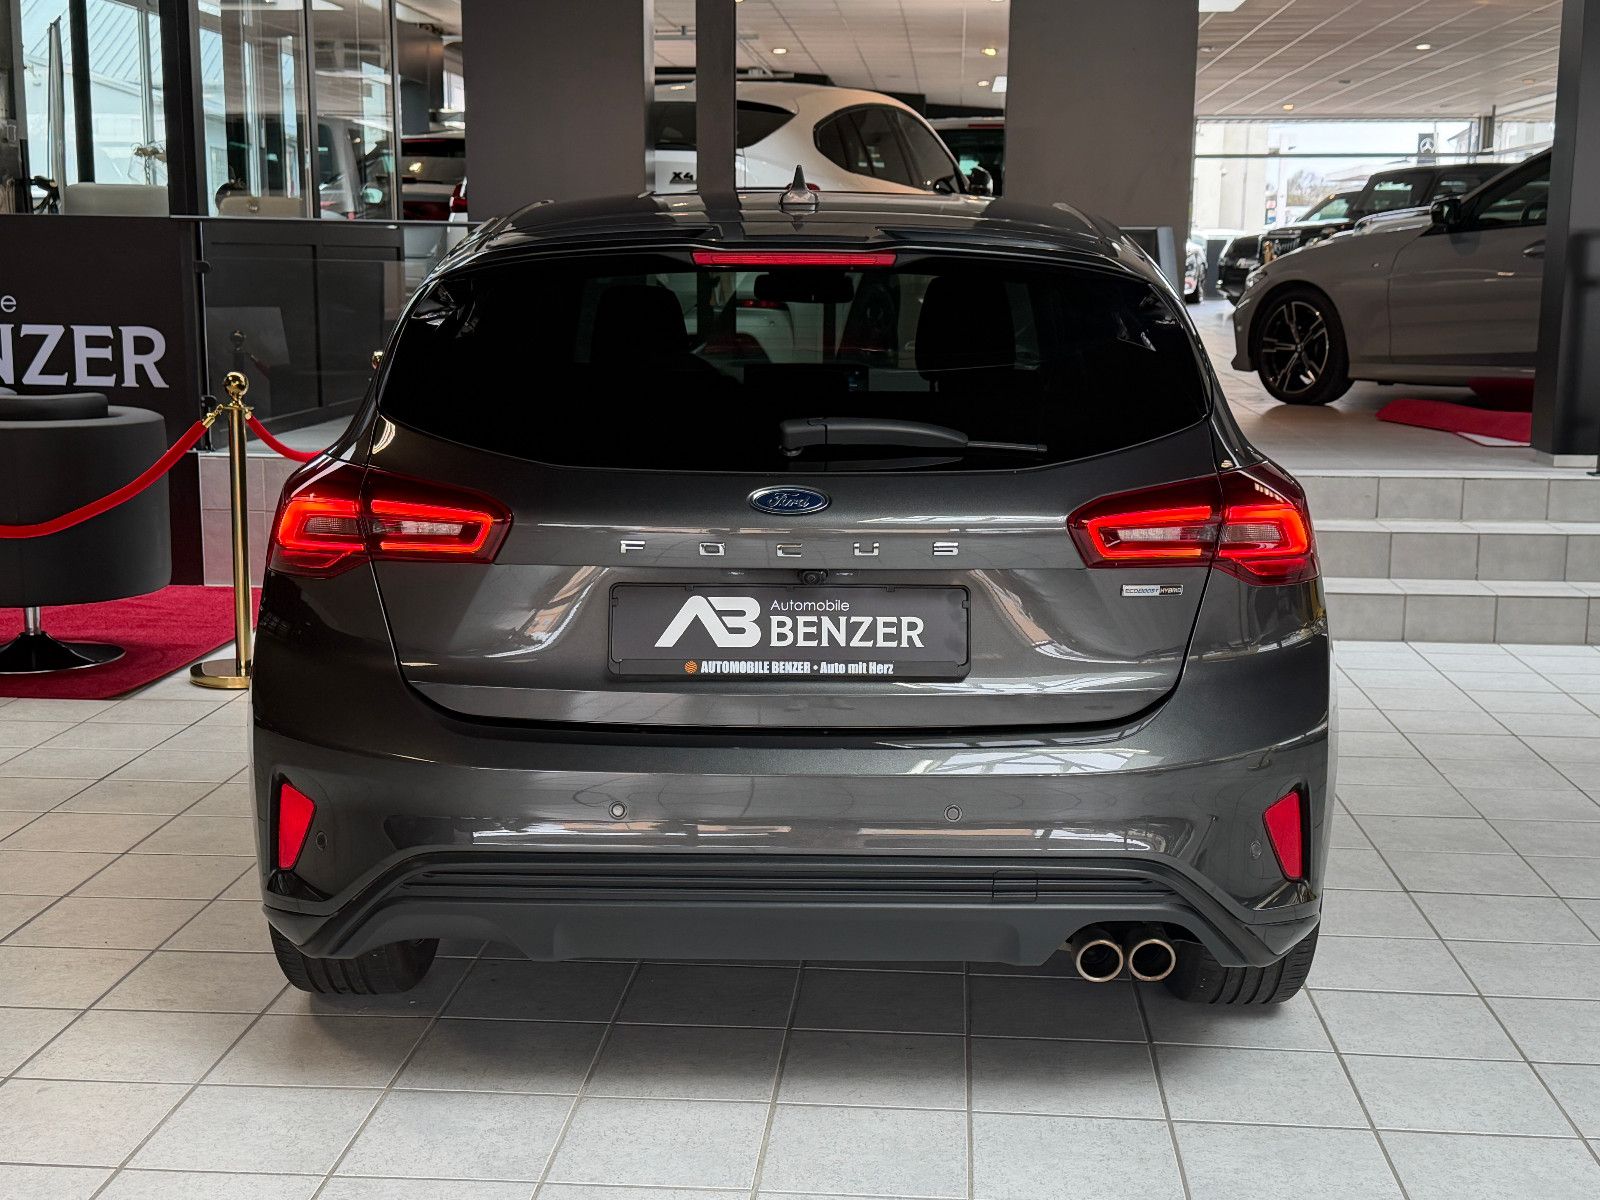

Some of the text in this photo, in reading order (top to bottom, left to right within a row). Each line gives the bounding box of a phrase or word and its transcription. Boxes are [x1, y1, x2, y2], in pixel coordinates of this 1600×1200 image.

[768, 492, 810, 508] Ford
[620, 540, 960, 557] FOCUS
[769, 599, 850, 612] Automobile
[769, 615, 925, 648] BENZER
[700, 660, 894, 675] AUTOMOBILE BENZER Auto mit Herz
